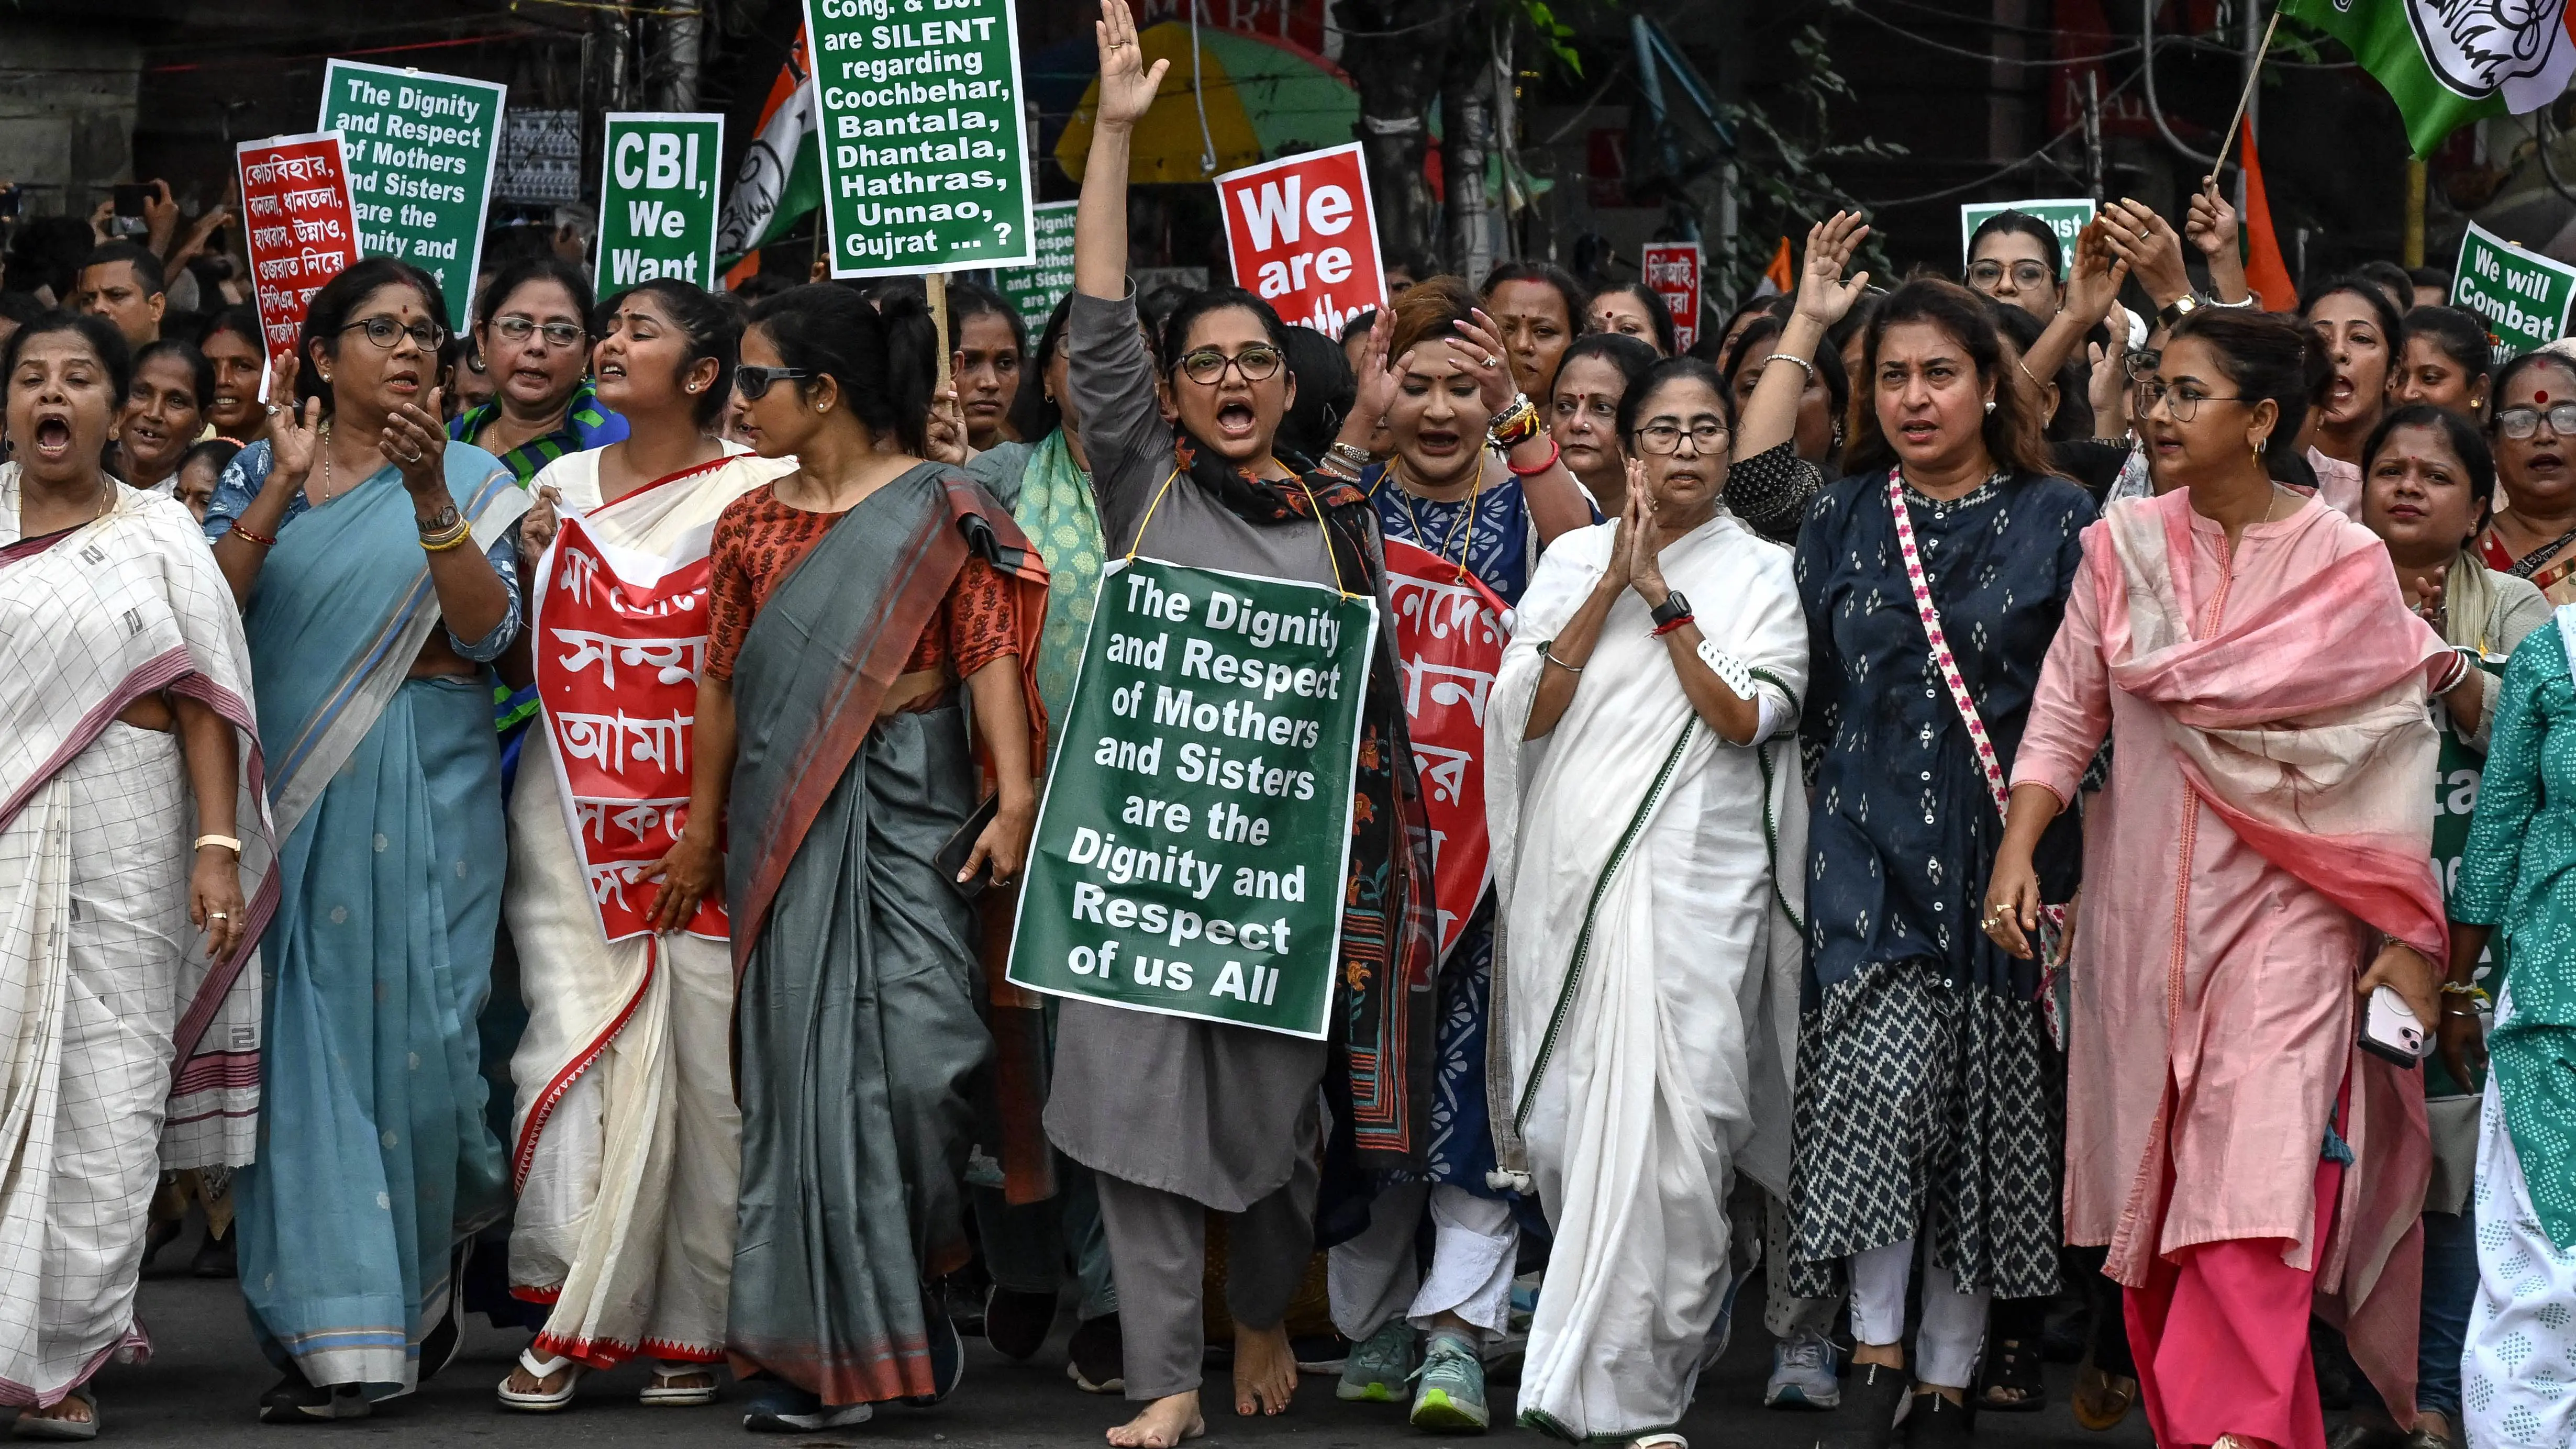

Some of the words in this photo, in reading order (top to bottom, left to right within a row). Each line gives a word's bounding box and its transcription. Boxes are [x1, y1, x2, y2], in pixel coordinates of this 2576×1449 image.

[823, 0, 895, 20] Cong.
[825, 32, 862, 51] are
[872, 17, 995, 49] SILENT
[842, 50, 982, 82] regarding
[348, 79, 390, 106] The
[398, 87, 480, 124] Dignity
[825, 79, 1008, 109] Coochbehar,
[336, 112, 379, 134] and
[386, 115, 481, 148] Respect
[838, 108, 999, 138] Bantala,
[345, 139, 367, 161] of
[373, 141, 465, 174] Mothers
[615, 132, 707, 199] CBI,
[837, 137, 1005, 168] Dhantala,
[246, 154, 334, 186] কোচবিহার,
[350, 171, 378, 192] nd
[384, 173, 464, 203] Sisters
[841, 171, 1006, 197] Hathras,
[356, 203, 393, 224] are
[401, 204, 436, 228] the
[629, 201, 685, 238] We
[858, 202, 992, 226] Unnao,
[1034, 214, 1076, 234] Dignit
[1237, 175, 1352, 252] We
[361, 229, 408, 259] nity
[414, 239, 457, 260] and
[846, 229, 938, 260] Gujrat
[1035, 236, 1074, 251] espe
[1036, 252, 1074, 269] other
[613, 249, 697, 284] Want
[1007, 274, 1032, 291] and
[1035, 271, 1074, 287] Siste
[1258, 247, 1352, 298] are
[2475, 245, 2500, 282] We
[2507, 269, 2550, 302] will
[1023, 294, 1045, 308] are
[1049, 289, 1064, 306] th
[2459, 276, 2553, 342] Combat
[1128, 574, 1190, 621] The
[1205, 591, 1340, 657] Dignity
[1107, 632, 1168, 671] and
[1181, 638, 1340, 700] Respect
[1112, 681, 1145, 718] of
[1153, 685, 1319, 749] Mothers
[1095, 737, 1163, 775] and
[1176, 743, 1314, 799] Sisters
[1123, 796, 1190, 832] are
[1208, 802, 1269, 845] the
[1068, 827, 1222, 899] Dignity
[1234, 865, 1304, 902] and
[1073, 882, 1290, 954] Respect
[1068, 941, 1119, 978] of
[1134, 956, 1193, 990] us
[1209, 961, 1279, 1005] All
